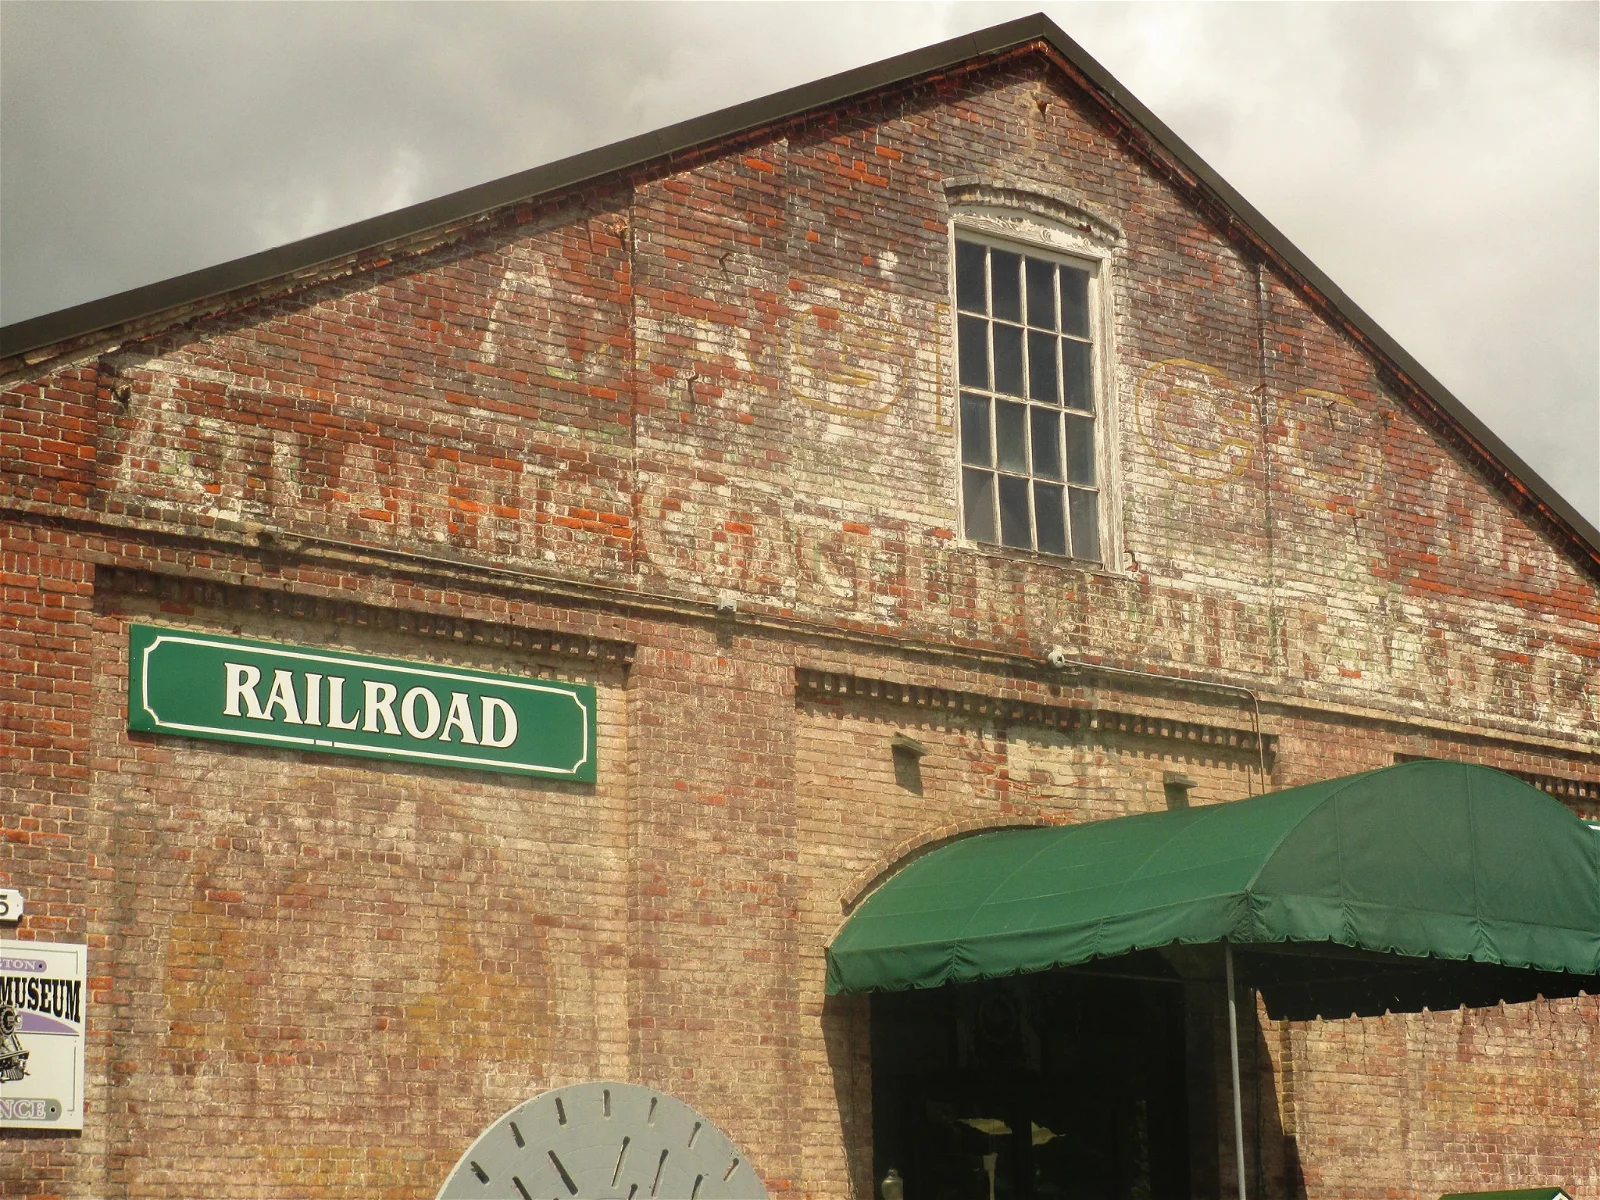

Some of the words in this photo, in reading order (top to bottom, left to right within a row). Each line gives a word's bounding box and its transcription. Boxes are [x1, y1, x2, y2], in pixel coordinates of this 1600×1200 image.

[223, 661, 519, 749] RAILROAD
[0, 959, 36, 970] TON
[0, 976, 81, 1024] MUSEUM
